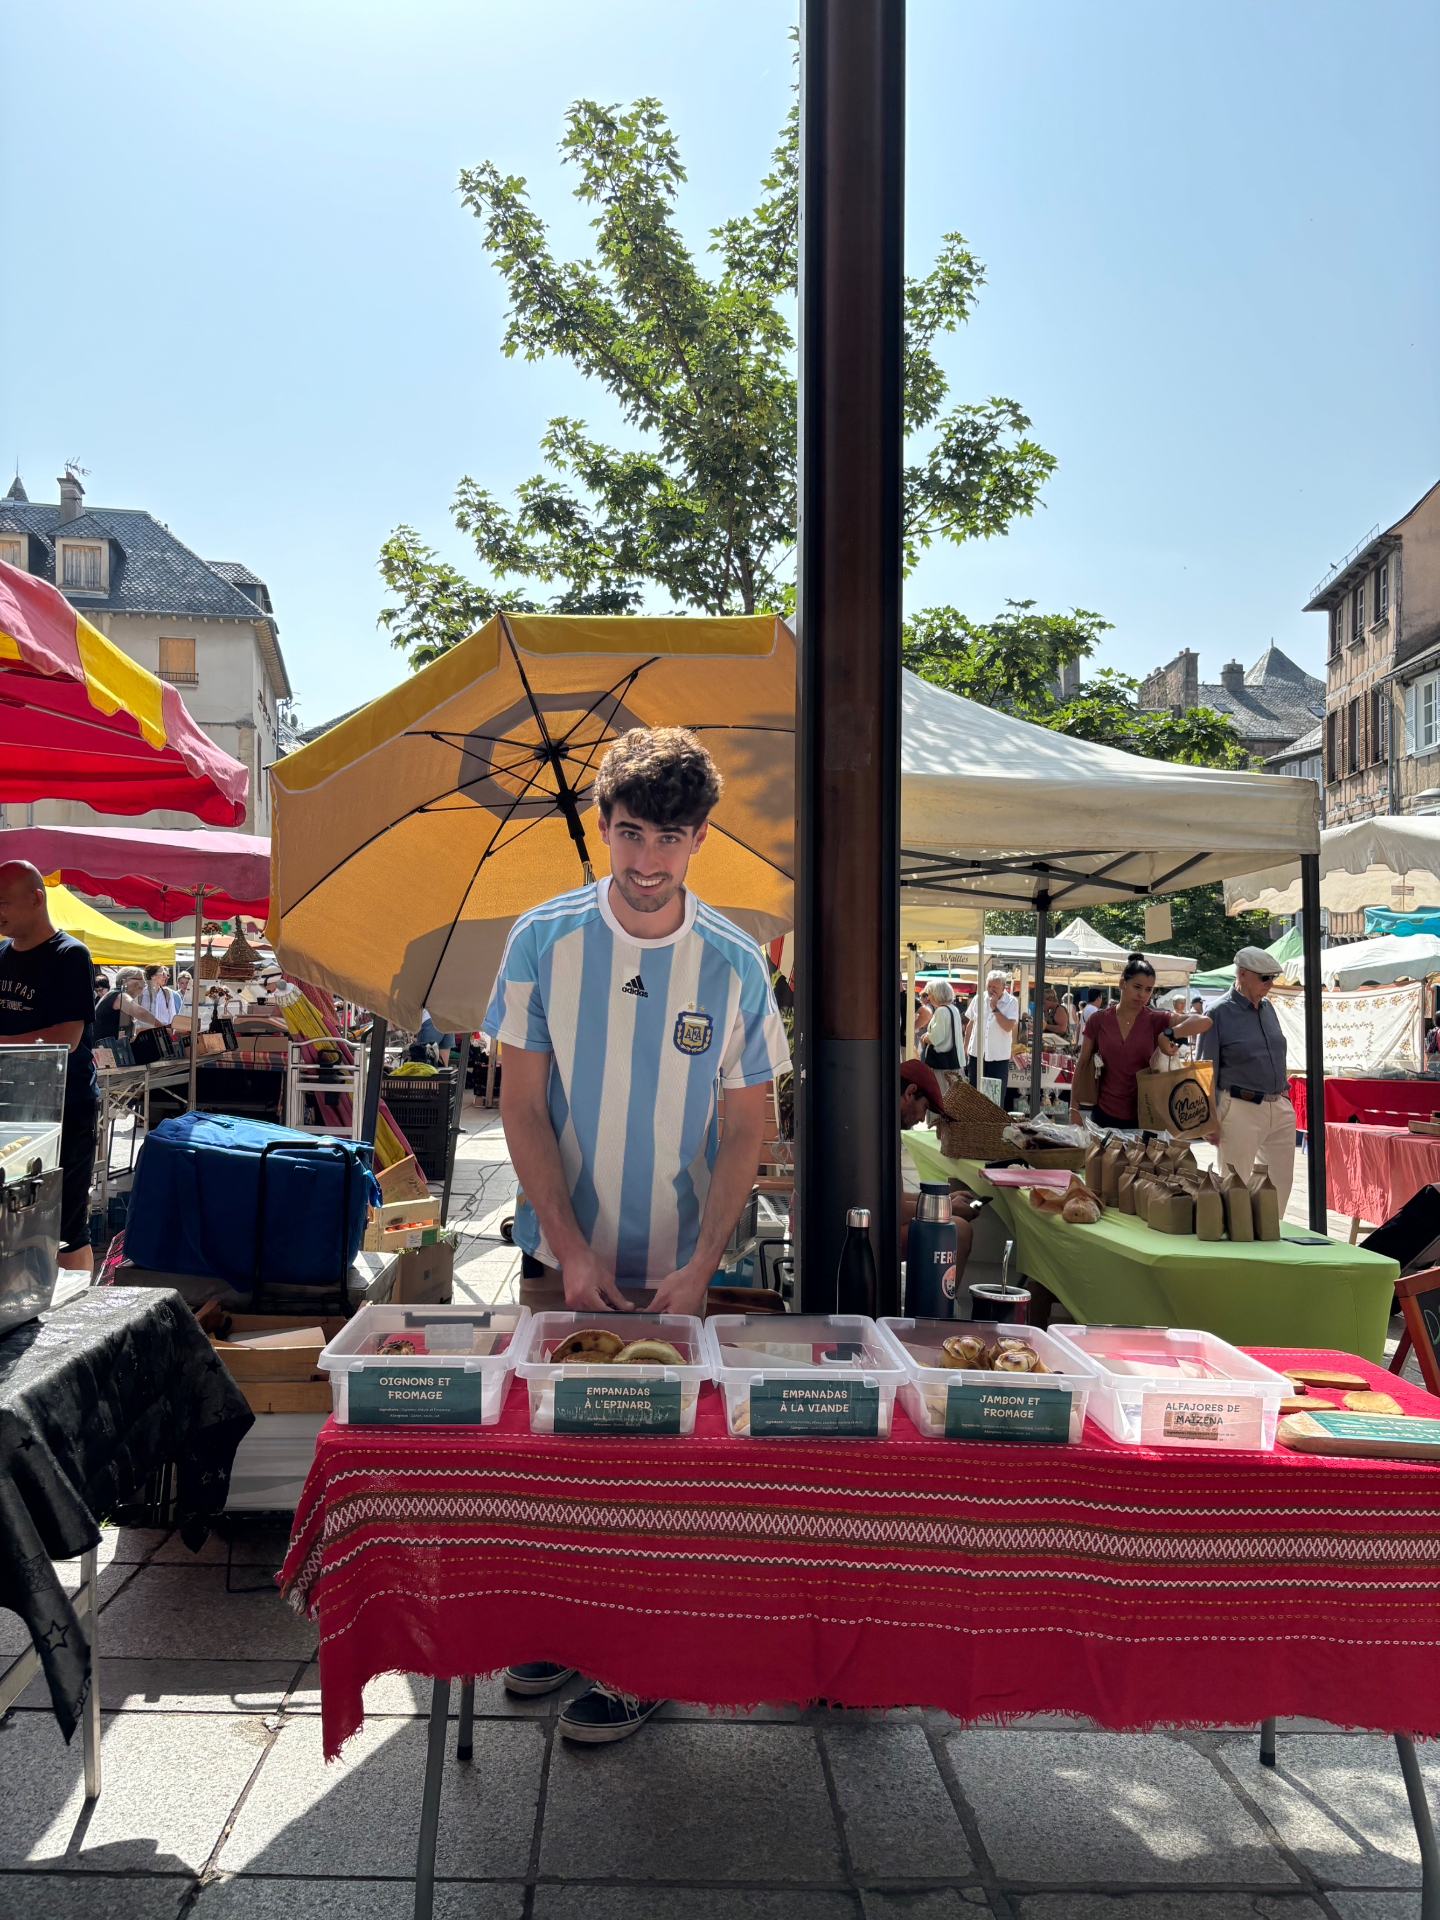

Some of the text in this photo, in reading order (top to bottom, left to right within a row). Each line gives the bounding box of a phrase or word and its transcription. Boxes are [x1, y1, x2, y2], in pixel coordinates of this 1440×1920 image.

[14, 982, 35, 1000] PAS
[621, 986, 649, 998] adidas
[684, 1025, 702, 1043] AFA
[379, 1377, 451, 1386] OIGNONS ET
[388, 1390, 443, 1400] FROMAGE
[586, 1387, 650, 1396] EMPANADAS
[782, 1390, 848, 1399] EMPANADAS
[584, 1398, 651, 1410] À L'EPINARD
[980, 1395, 1040, 1406] JAMBON ET
[780, 1401, 849, 1413] À LA VIANDE
[983, 1407, 1034, 1418] FROMAGE
[1165, 1402, 1240, 1412] ALFAJORES DE
